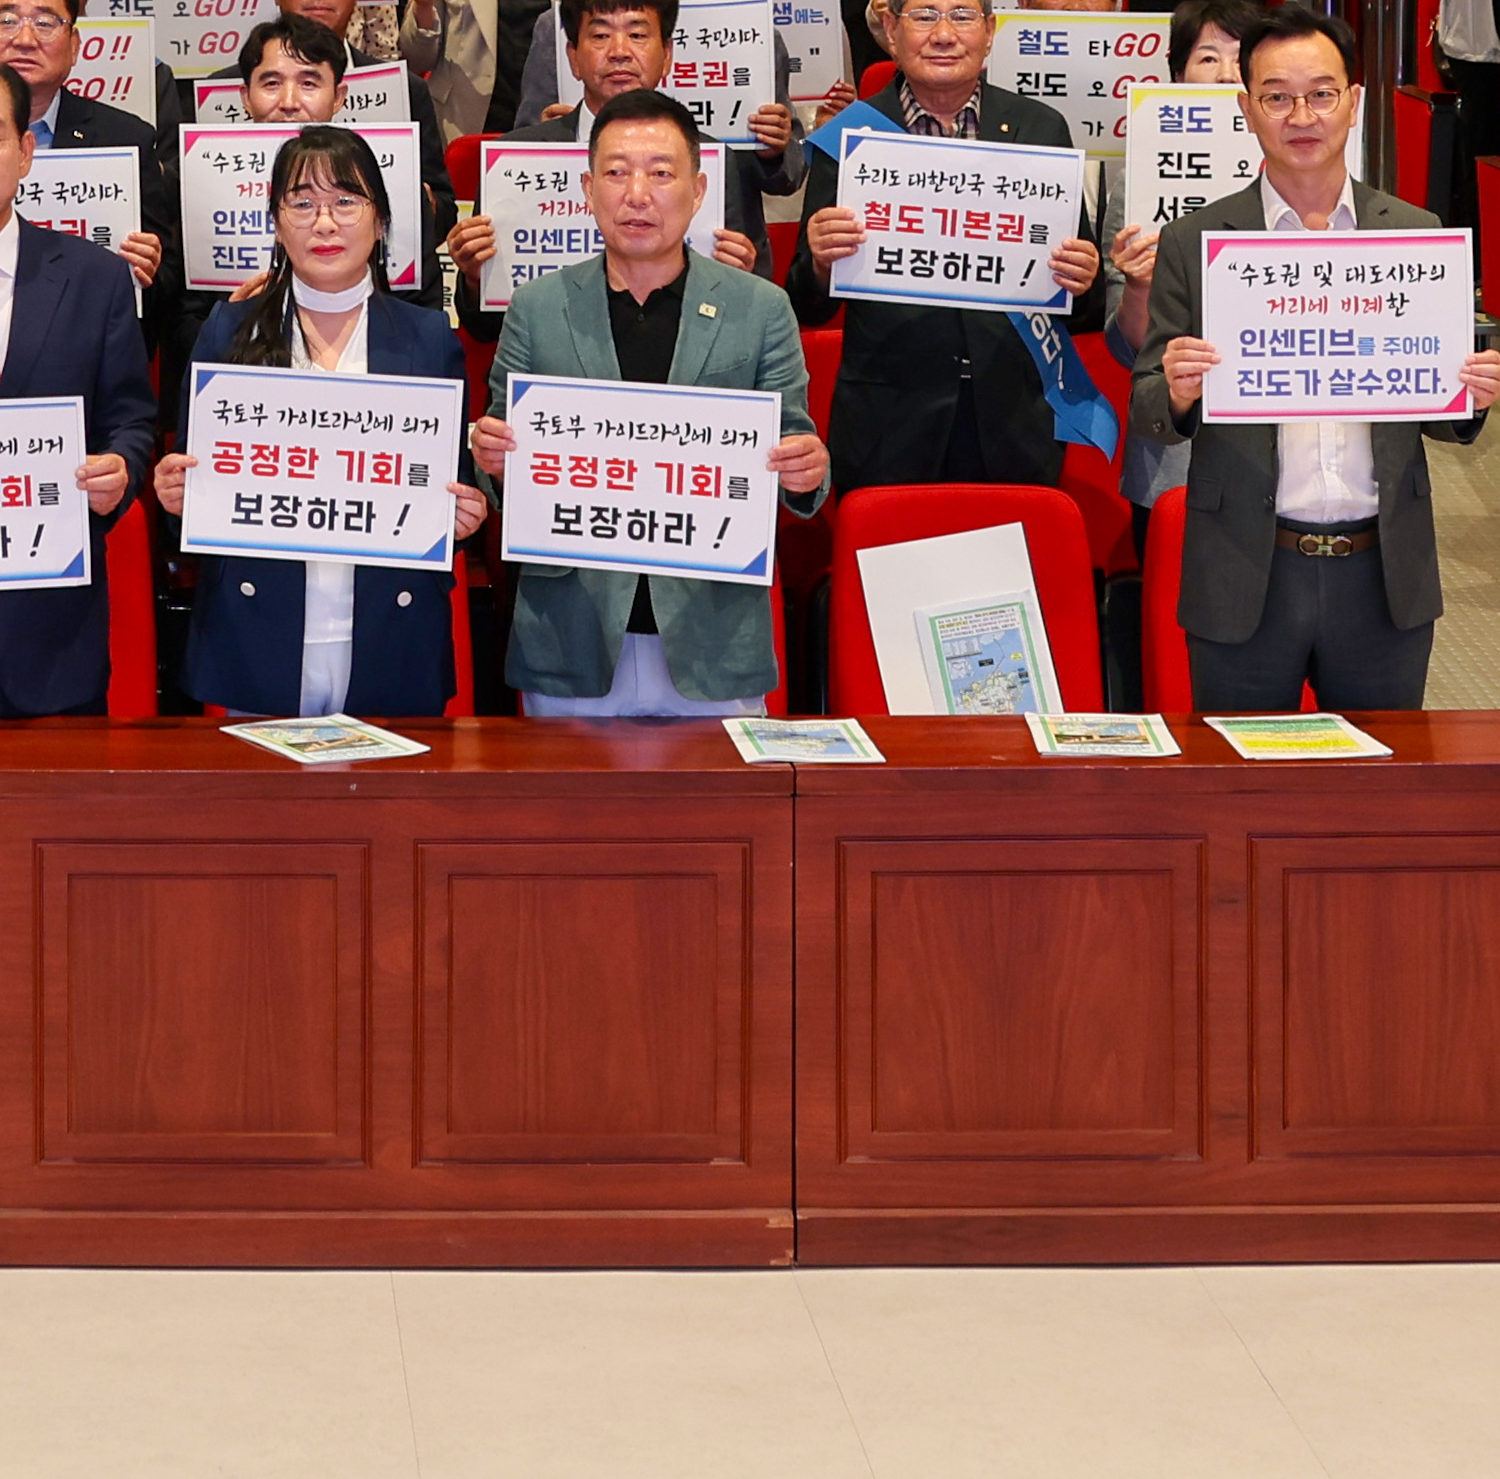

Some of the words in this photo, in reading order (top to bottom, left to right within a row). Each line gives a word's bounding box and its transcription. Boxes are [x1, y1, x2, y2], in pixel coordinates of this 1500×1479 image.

[854, 162, 901, 187] 우리도
[907, 169, 985, 197] 대한민국
[992, 175, 1068, 203] 국민이다.
[864, 200, 1049, 245] 철도기본권을
[1313, 261, 1332, 288] 및
[1345, 263, 1445, 284] 대도시와의
[1266, 295, 1328, 315] 거리에
[1341, 291, 1410, 318] 비례한
[1239, 328, 1375, 357] 인센티브를
[1382, 335, 1440, 356] 주어야
[1237, 368, 1321, 397] 진도가
[1328, 367, 1447, 396] 살수있다.
[212, 399, 268, 427] 국토부
[276, 407, 393, 434] 가이드라인에
[401, 416, 439, 435] 의거
[211, 441, 319, 479] 공정한
[336, 449, 430, 487] 기회를
